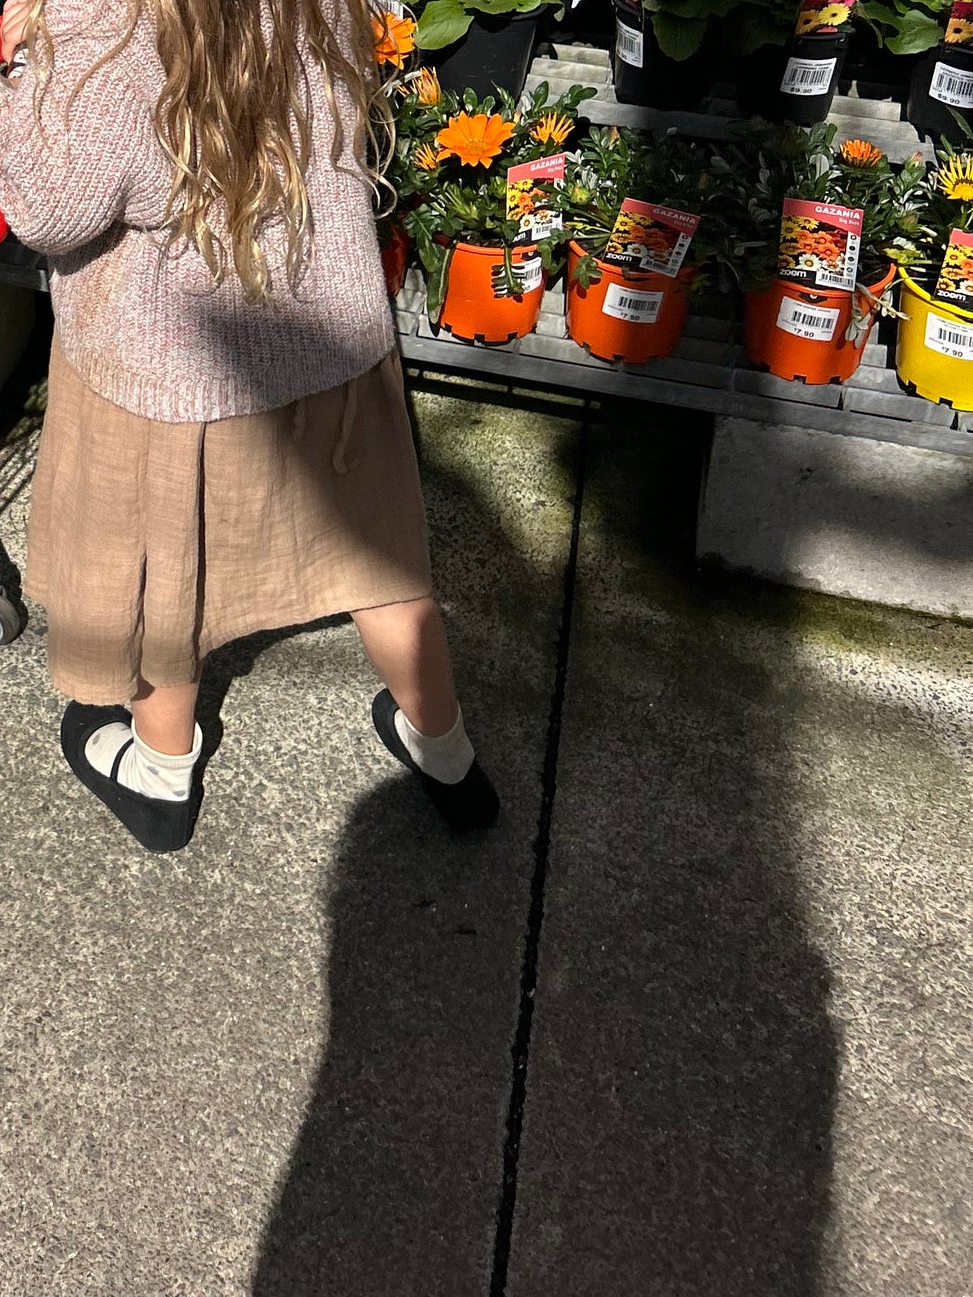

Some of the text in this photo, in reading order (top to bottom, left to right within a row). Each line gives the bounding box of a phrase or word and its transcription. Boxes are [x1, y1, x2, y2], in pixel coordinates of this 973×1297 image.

[937, 92, 960, 105] $9.90
[530, 157, 563, 172] GAZANIA
[653, 207, 696, 224] GAZANIA
[815, 205, 861, 220] GAZANIA
[605, 252, 633, 263] zoom
[779, 268, 808, 278] zoom
[937, 289, 967, 301] zoom
